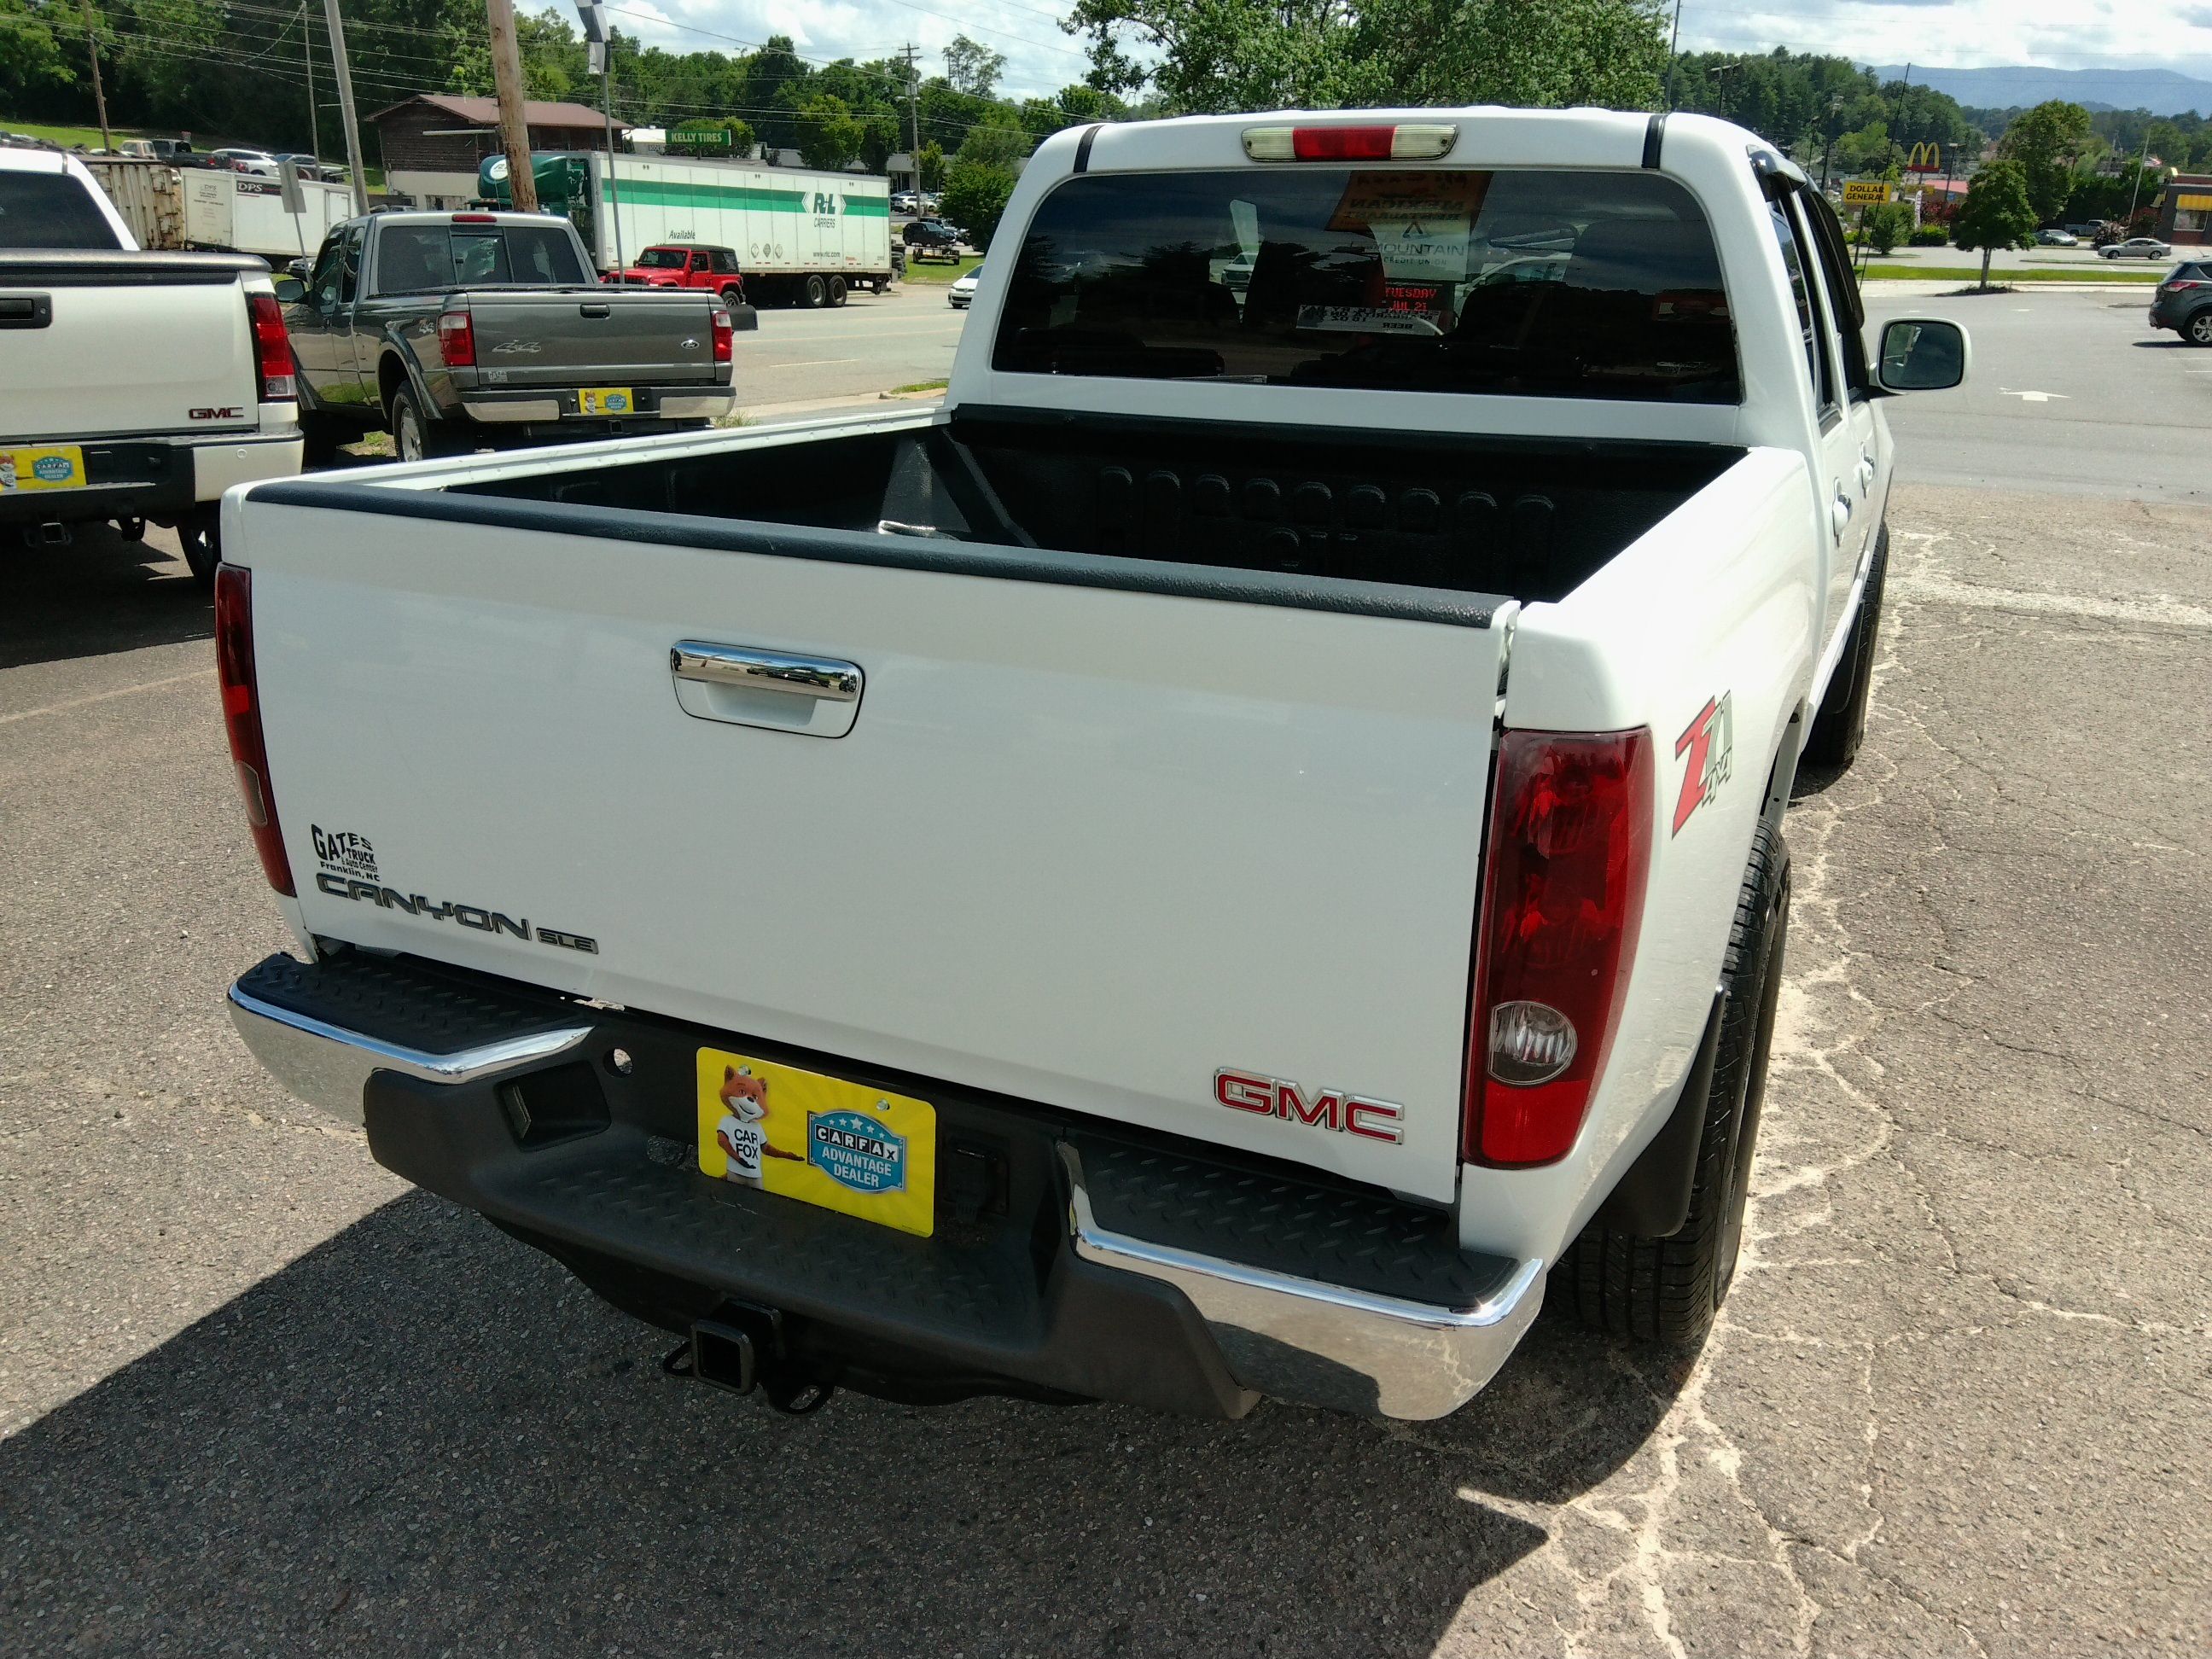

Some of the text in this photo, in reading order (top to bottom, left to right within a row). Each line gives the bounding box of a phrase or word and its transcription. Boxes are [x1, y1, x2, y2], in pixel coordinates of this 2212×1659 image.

[672, 132, 722, 143] KELLY TIRES
[237, 182, 263, 192] DPS
[1849, 184, 1885, 193] DOLLAR
[1846, 192, 1885, 201] GENERAL
[813, 218, 835, 229] CARRIERS
[668, 230, 696, 240] Available
[1385, 288, 1437, 299] TUESDAY
[189, 406, 244, 420] GMC
[311, 824, 373, 861] GATES
[346, 847, 376, 865] TRUCK
[320, 861, 381, 882] Franklin, NC
[316, 872, 533, 940] CANYON
[537, 928, 598, 954] SLE
[1214, 1067, 1405, 1145] GMC
[734, 1128, 759, 1146] CAR
[816, 1125, 898, 1161] CARFAX
[736, 1142, 760, 1161] FOX
[822, 1146, 892, 1176] ADVANTAGE
[833, 1163, 879, 1187] DEALER
